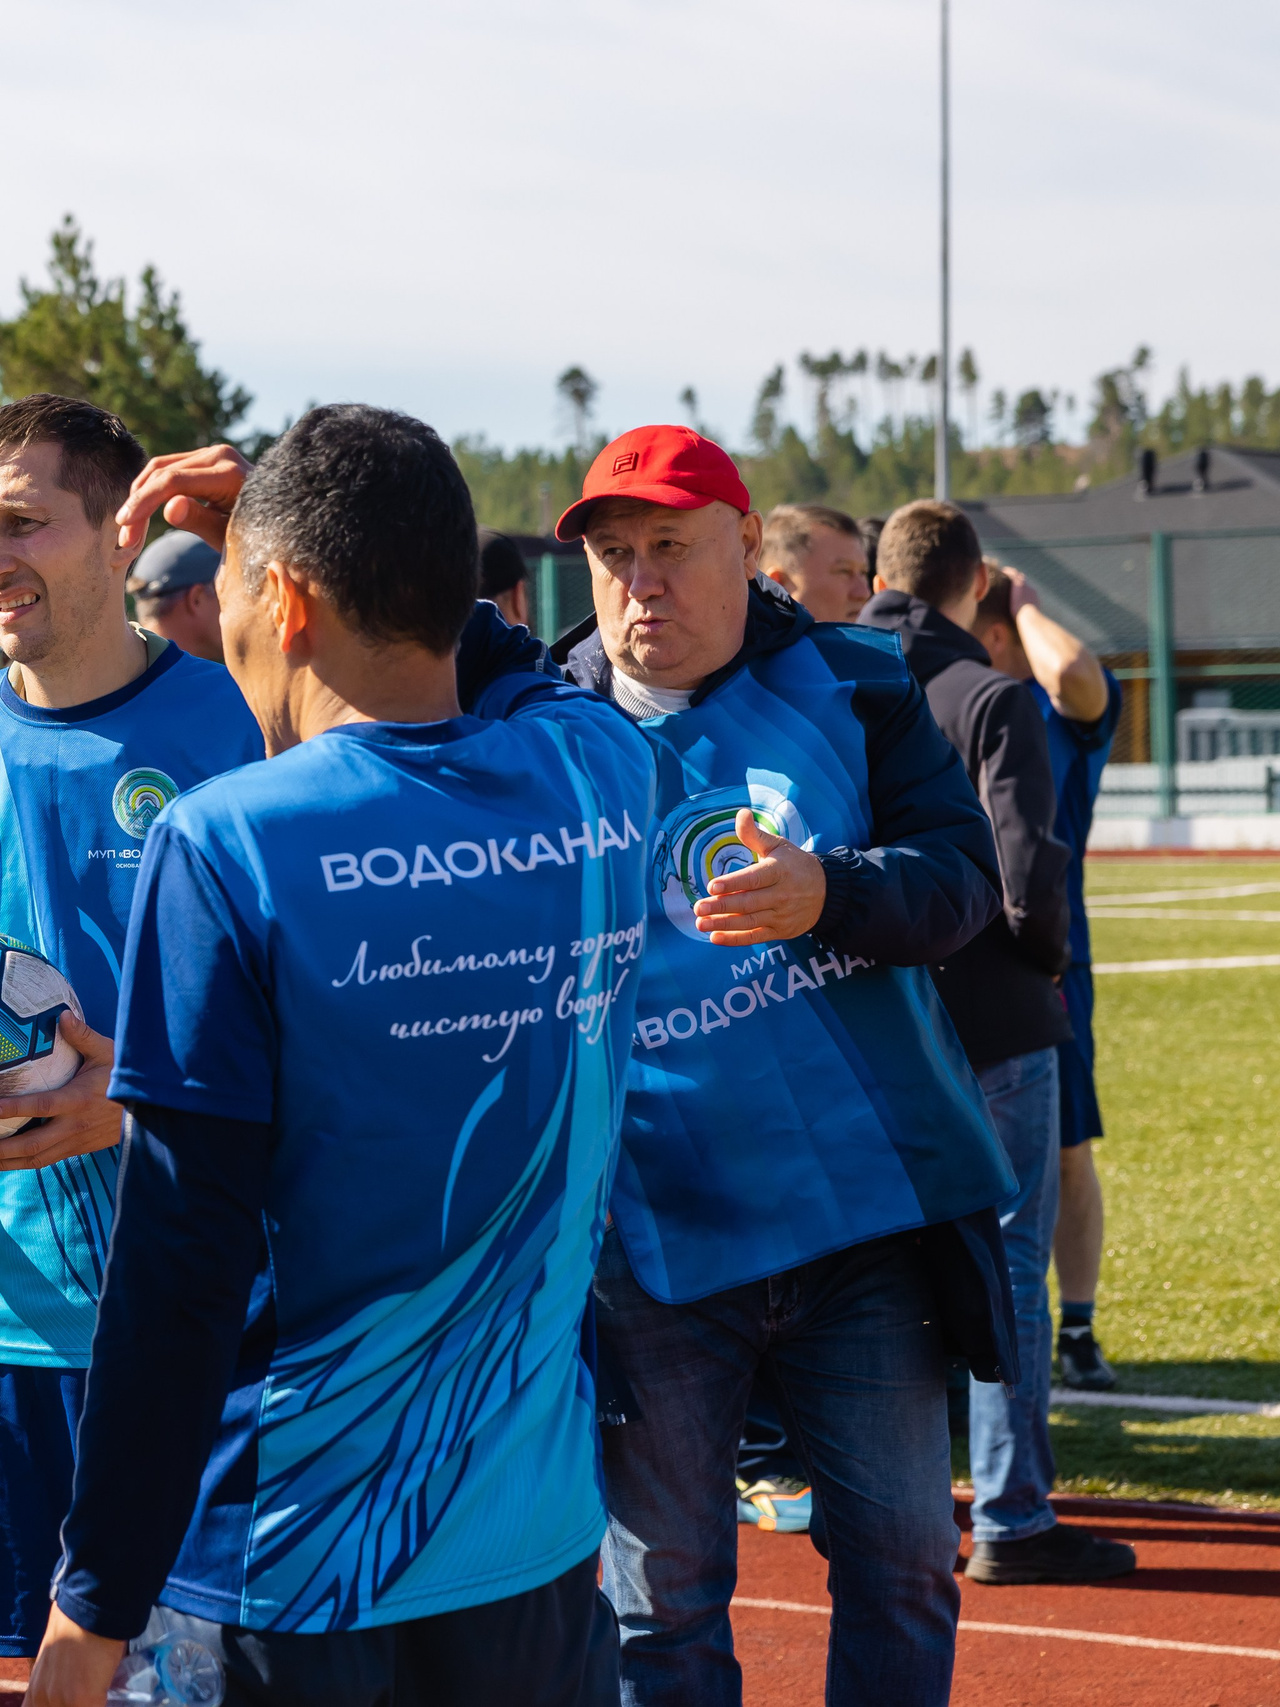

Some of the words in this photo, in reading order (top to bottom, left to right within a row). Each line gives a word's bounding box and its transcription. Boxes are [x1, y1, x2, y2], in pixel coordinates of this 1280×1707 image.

[88, 849, 116, 859] МУП
[118, 848, 142, 859] «ВО
[115, 862, 141, 870] ОСНОВА
[320, 809, 642, 892] ВОДОКАНАЛ
[332, 935, 556, 988] Любимому
[730, 945, 787, 980] МУП
[390, 1007, 544, 1063] чистую
[556, 968, 629, 1045] воду!
[632, 951, 876, 1050] «ВОДОКАНА
